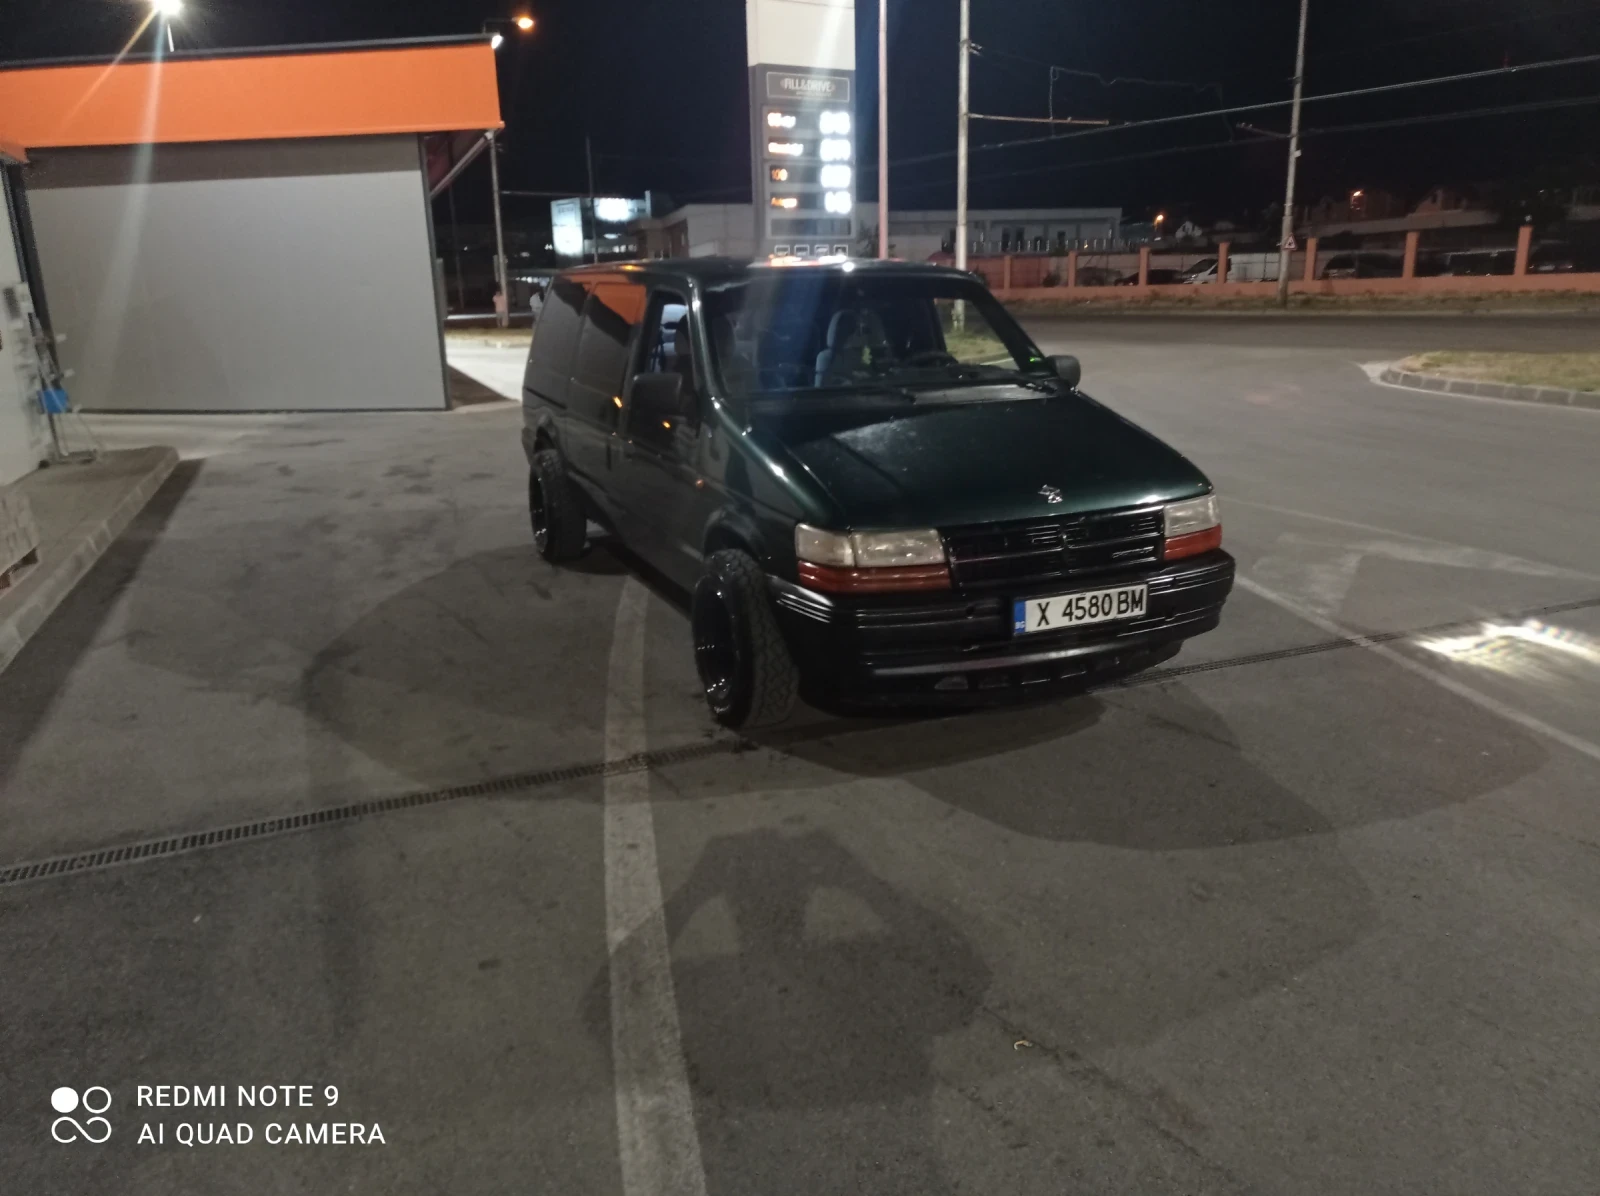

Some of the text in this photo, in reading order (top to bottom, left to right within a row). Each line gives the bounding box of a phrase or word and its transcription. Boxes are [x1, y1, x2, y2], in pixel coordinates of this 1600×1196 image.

[1037, 588, 1145, 627] X 4580 BM
